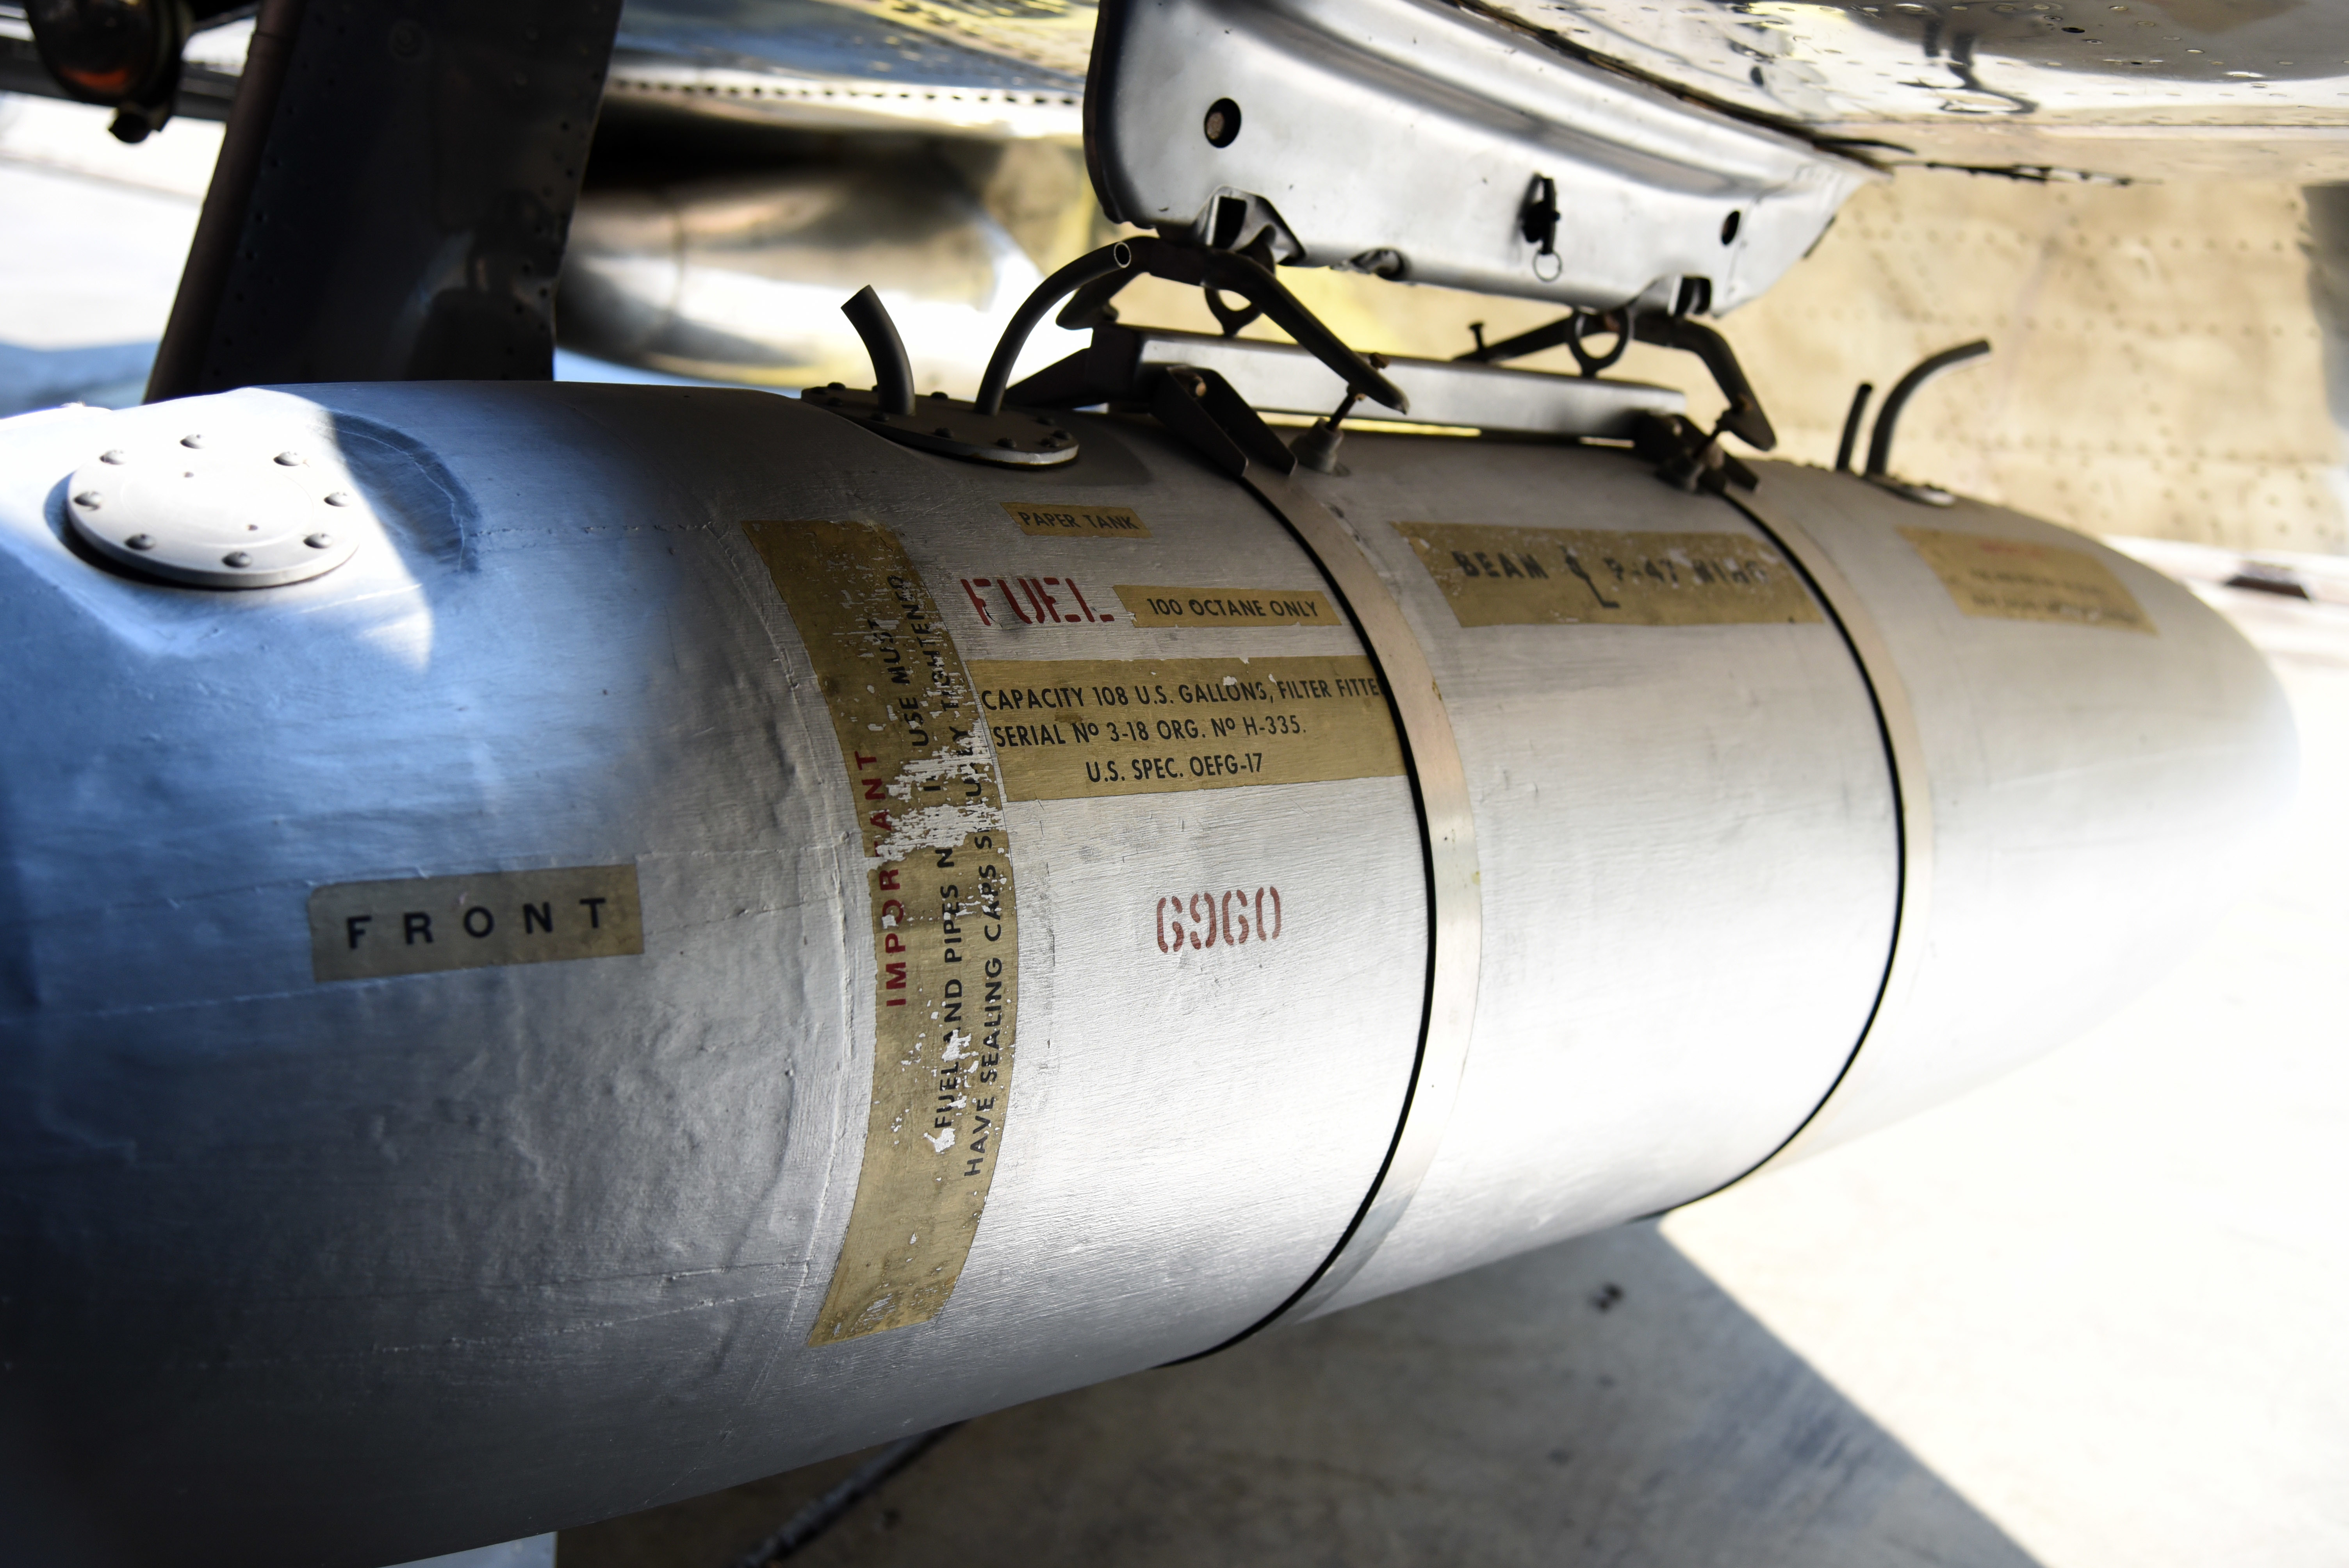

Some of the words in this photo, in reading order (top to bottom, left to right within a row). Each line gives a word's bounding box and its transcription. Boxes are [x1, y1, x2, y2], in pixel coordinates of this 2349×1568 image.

[1018, 511, 1081, 527] PAPER
[1082, 515, 1140, 529] TANK
[1451, 551, 1549, 579] BEAM
[961, 577, 1114, 626] FUEL
[1147, 598, 1183, 615] 100
[1189, 599, 1267, 617] OCTANE
[1269, 600, 1318, 617] ONLY
[982, 687, 1084, 710] CAPACITY
[1093, 686, 1129, 706] 108
[1135, 685, 1174, 705] U.S.
[1178, 681, 1274, 704] GALLONS,
[1276, 680, 1332, 699] FILTER
[1336, 678, 1385, 697] FITTE
[900, 697, 930, 747] USE
[993, 724, 1066, 747] SERIAL
[1107, 721, 1149, 742] 3-18
[1157, 719, 1206, 740] ORG.
[1242, 715, 1306, 736] H-335.
[1086, 761, 1125, 782] U.S.
[1132, 757, 1183, 780] SPEC.
[1190, 752, 1262, 777] OEFG-17
[346, 897, 606, 950] FRONT
[939, 884, 962, 963] PIPES
[978, 864, 1001, 942] CAPS
[1157, 886, 1281, 953] 6960
[978, 956, 1002, 1083] SEALING
[935, 1061, 959, 1128] FUEL
[964, 1095, 995, 1176] HAVE
